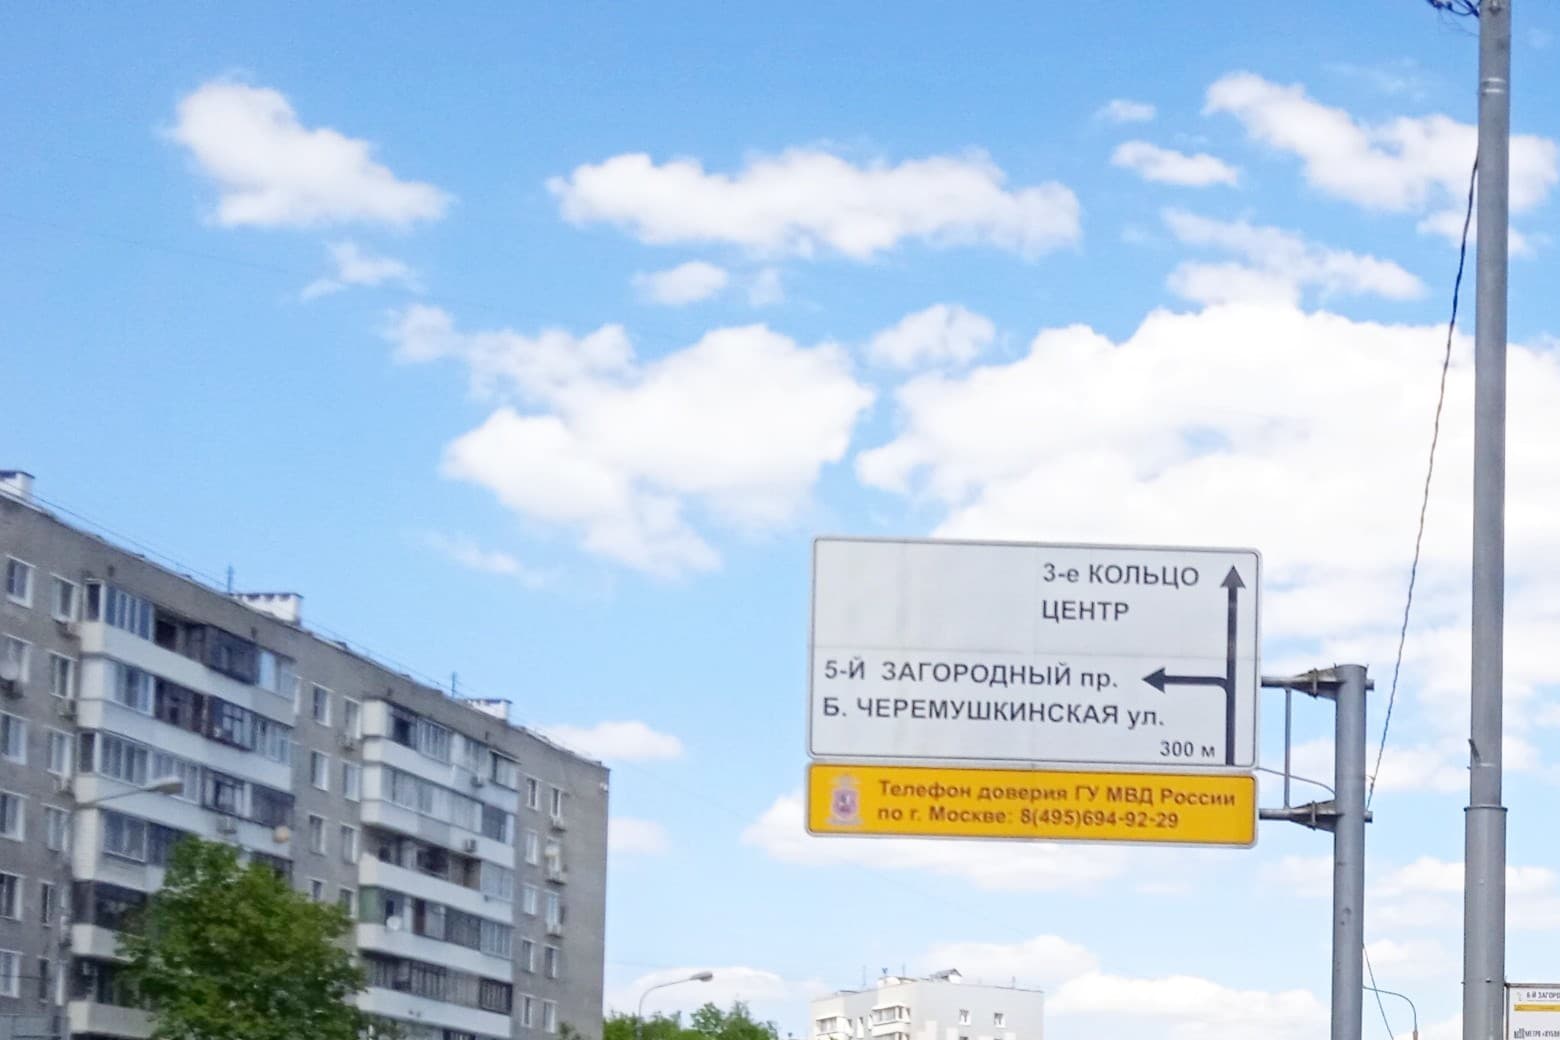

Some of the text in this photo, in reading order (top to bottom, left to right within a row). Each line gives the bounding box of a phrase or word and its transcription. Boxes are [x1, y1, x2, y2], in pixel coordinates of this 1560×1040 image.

[1043, 563, 1199, 588] 3-е КОЛЬЦО
[1042, 599, 1129, 622] ЦЕНТР
[824, 656, 1118, 690] 5-Й ЗАГОРОДНЫЙ пр.
[823, 697, 1164, 730] Б. ЧЕРЕМУШКИНСКАЯ ул.
[1160, 741, 1216, 758] 300 м
[878, 780, 1236, 806] Телефон доверия ГУ МВД России
[878, 806, 1179, 829] по г. Москве: 8(495)694-92-29
